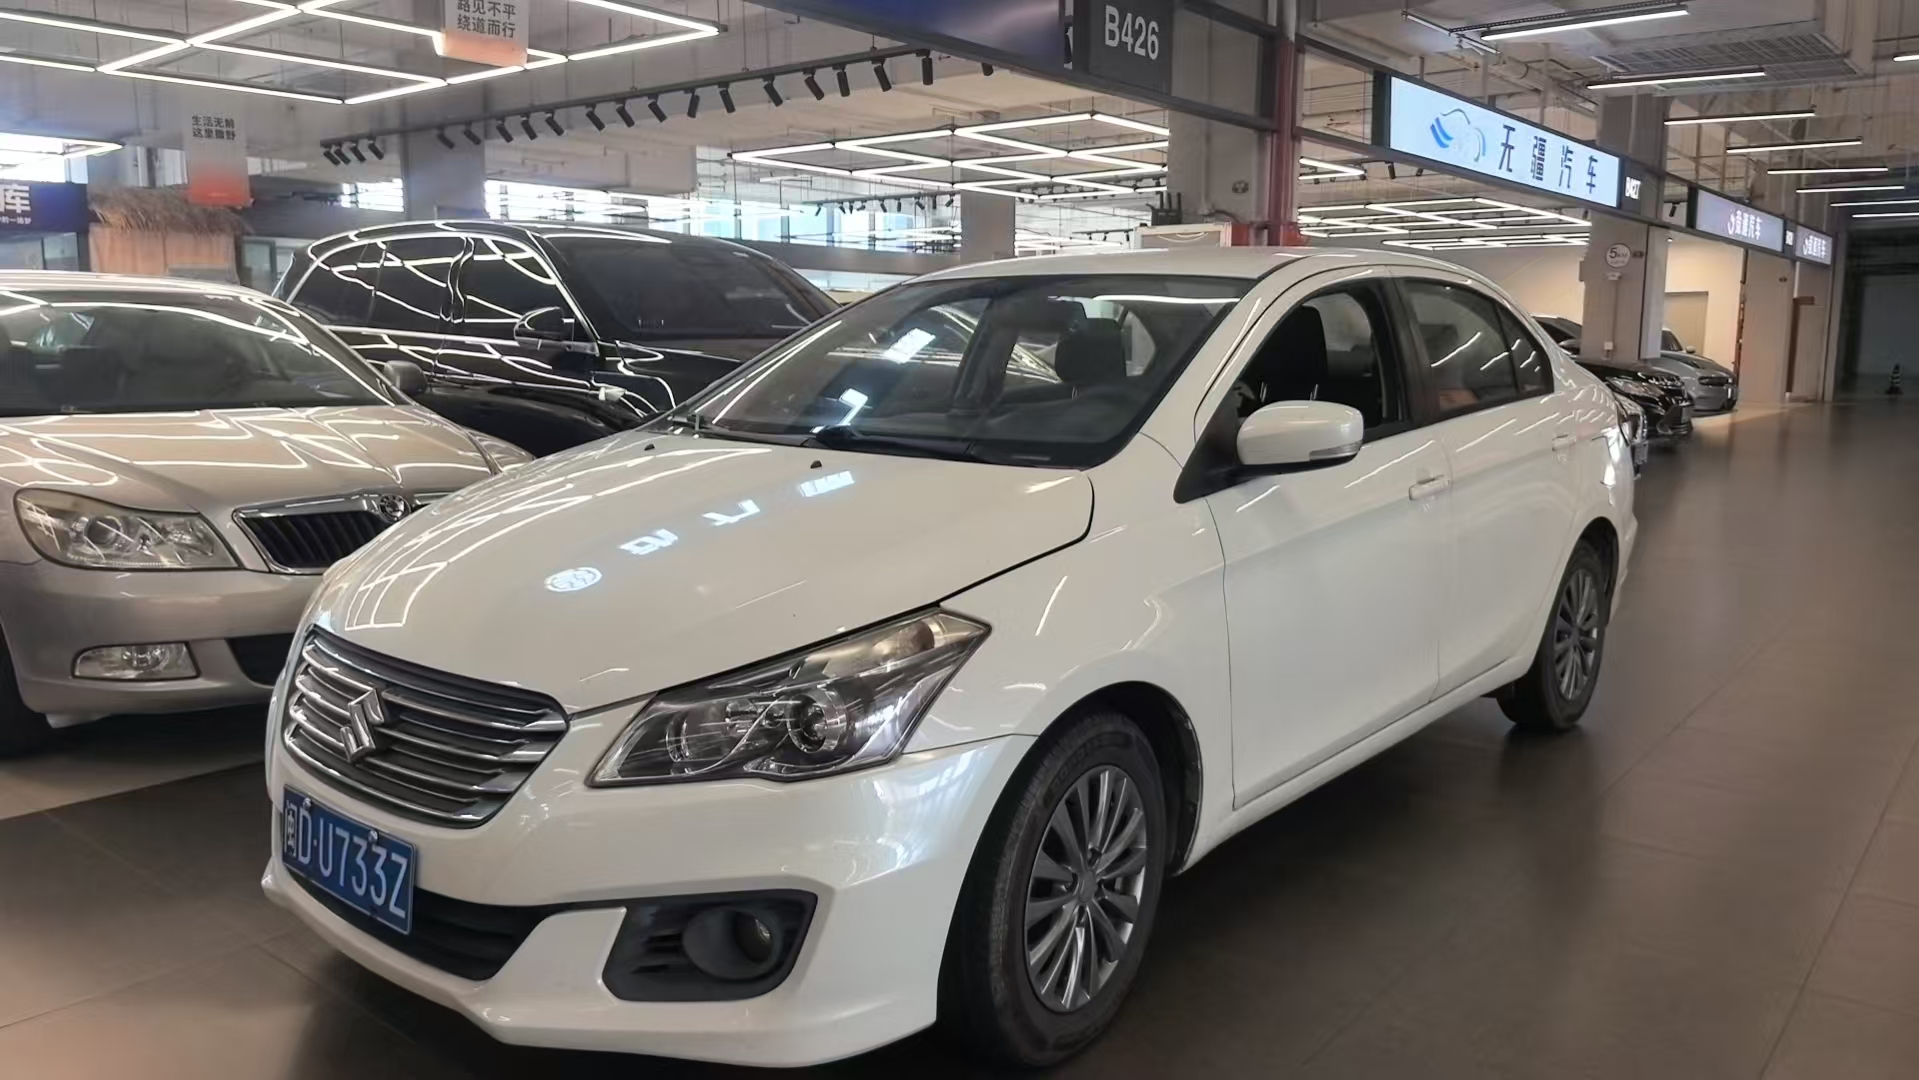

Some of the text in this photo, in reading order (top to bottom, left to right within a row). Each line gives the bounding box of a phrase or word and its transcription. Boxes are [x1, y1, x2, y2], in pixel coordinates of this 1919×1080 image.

[457, 0, 516, 19] 路见不平
[457, 14, 516, 38] 绕道而行
[1105, 4, 1159, 60] B426
[1498, 123, 1599, 194] 无疆汽车
[0, 184, 31, 213] 库
